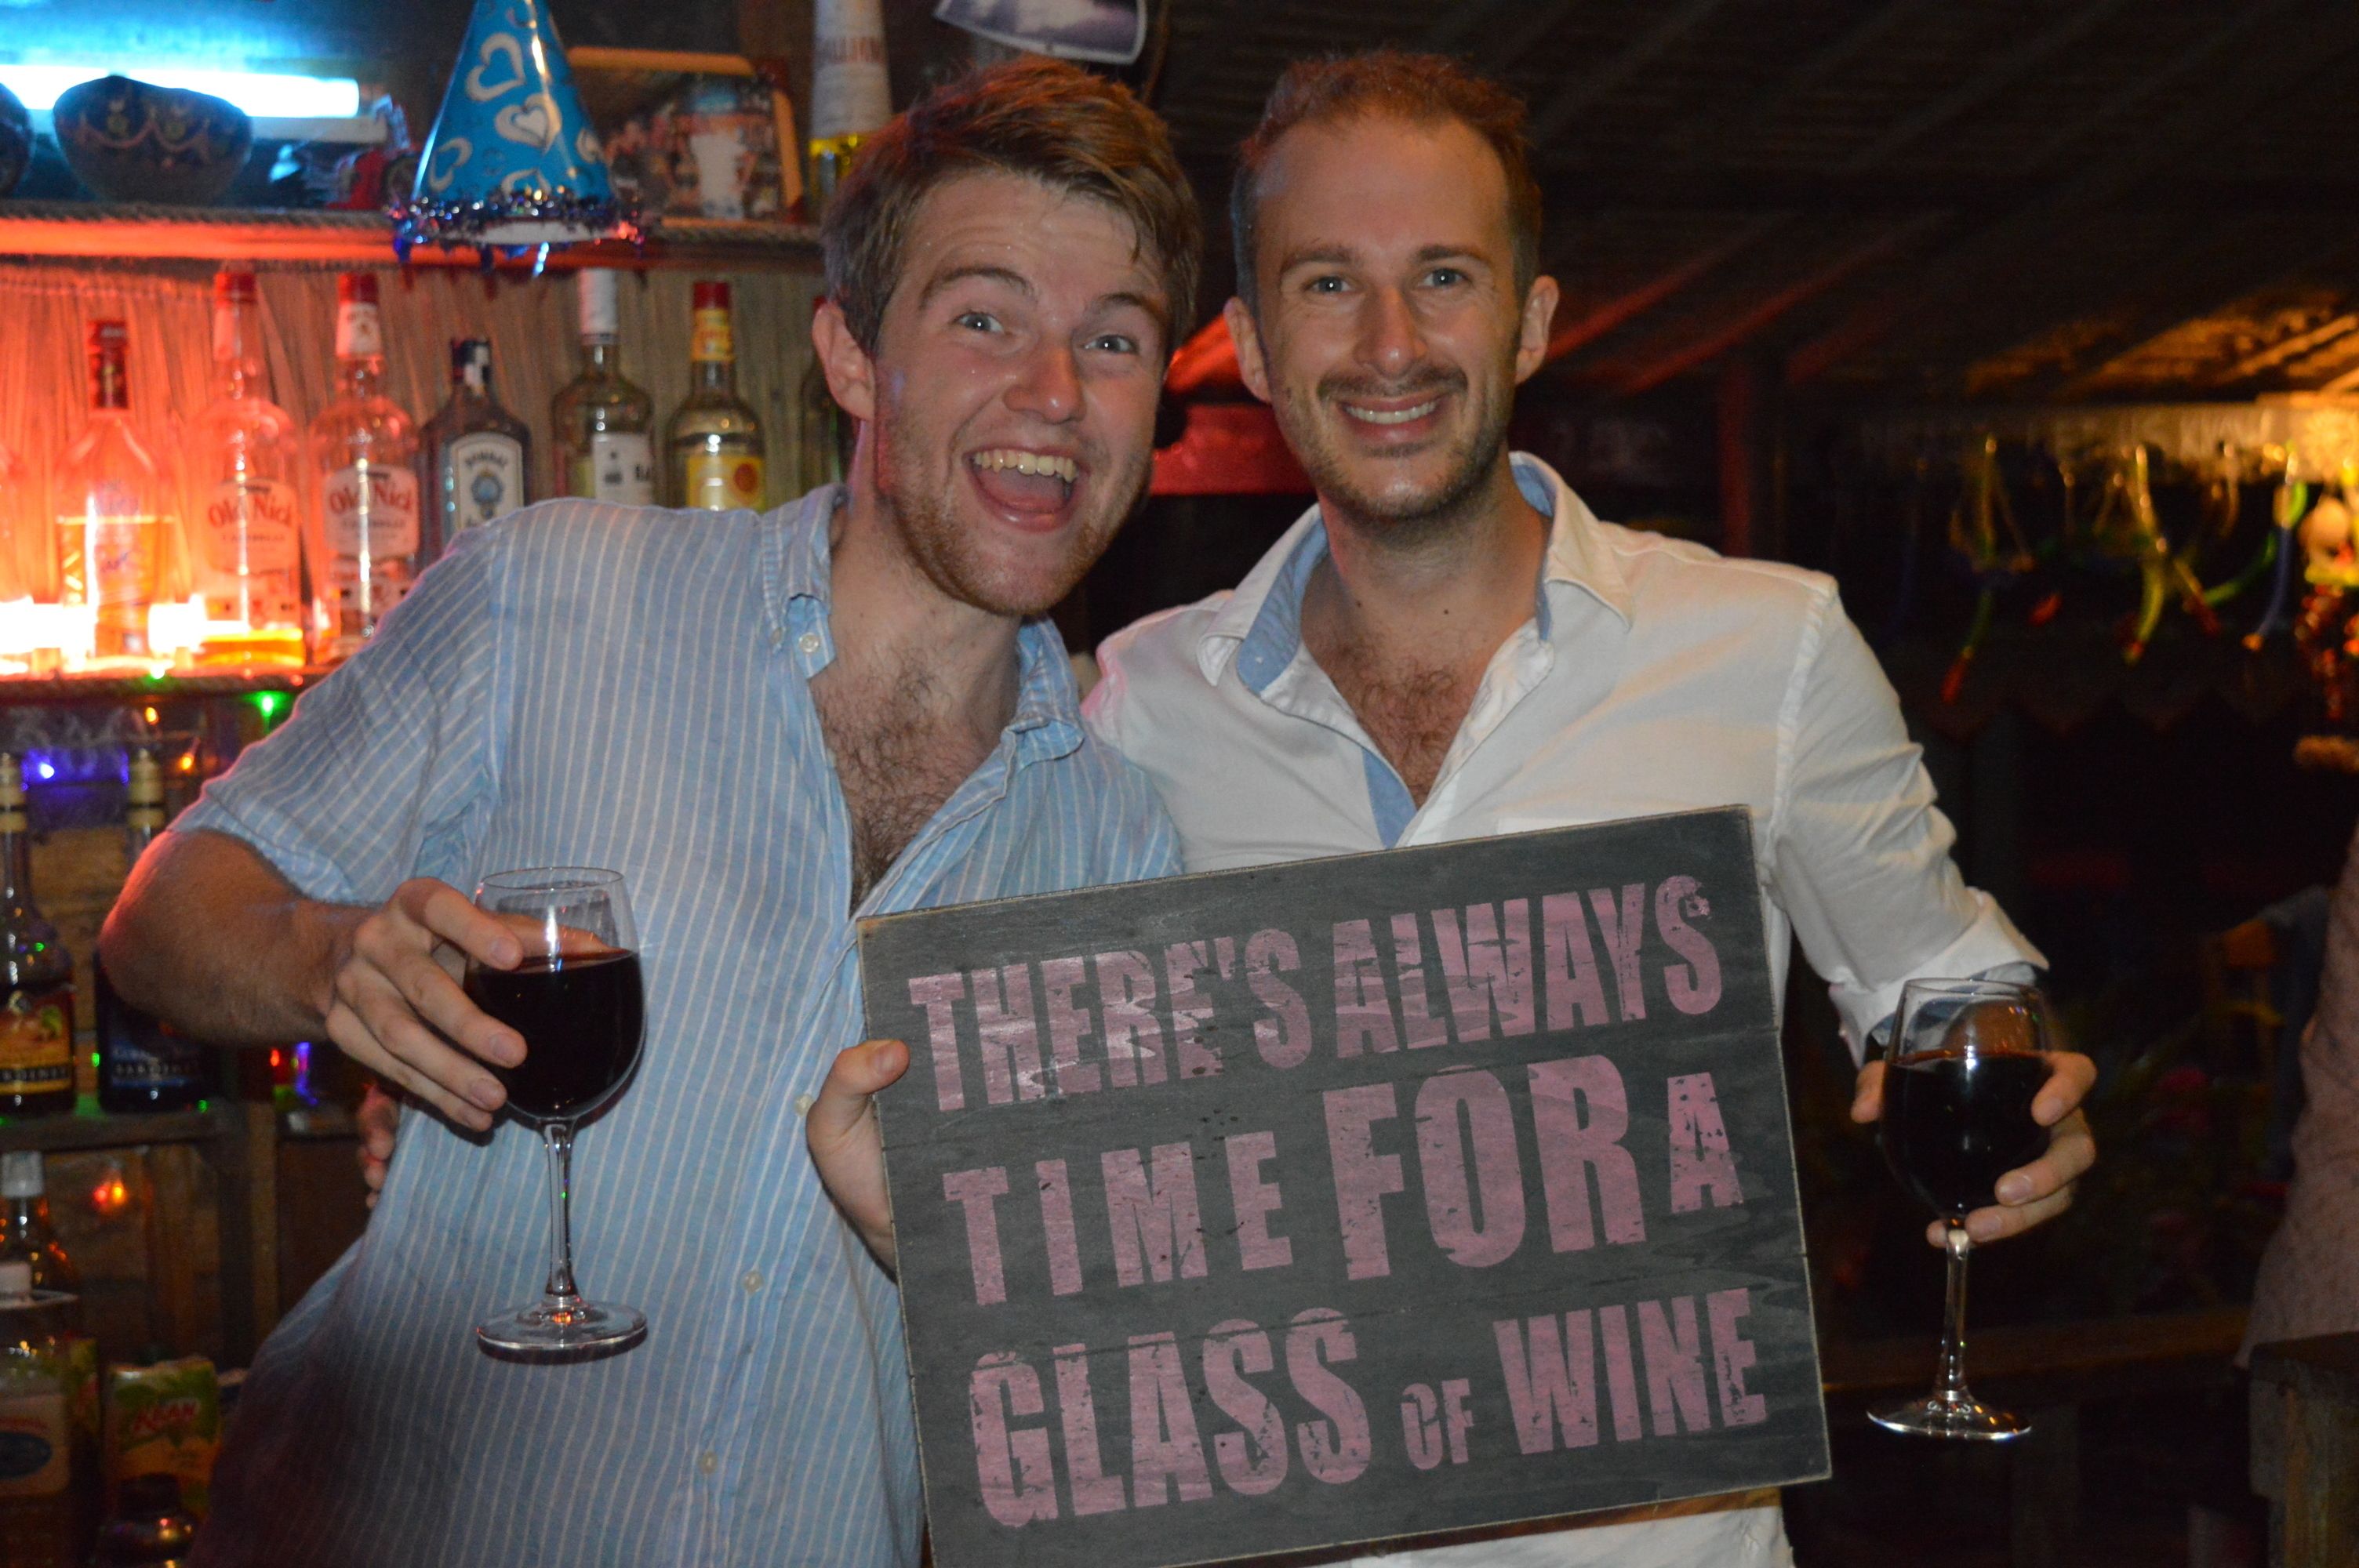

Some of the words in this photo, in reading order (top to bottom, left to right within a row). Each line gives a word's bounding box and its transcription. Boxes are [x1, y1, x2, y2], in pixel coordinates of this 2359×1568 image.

[909, 929, 1312, 1111] THERE'S
[1333, 876, 1722, 1058] ALWAYS
[943, 1131, 1292, 1305] TIME
[1323, 1054, 1645, 1280] FOR
[1667, 1073, 1743, 1214] A
[970, 1308, 1372, 1528] GLASS
[1401, 1378, 1474, 1471] OF
[1493, 1287, 1768, 1454] WINE
